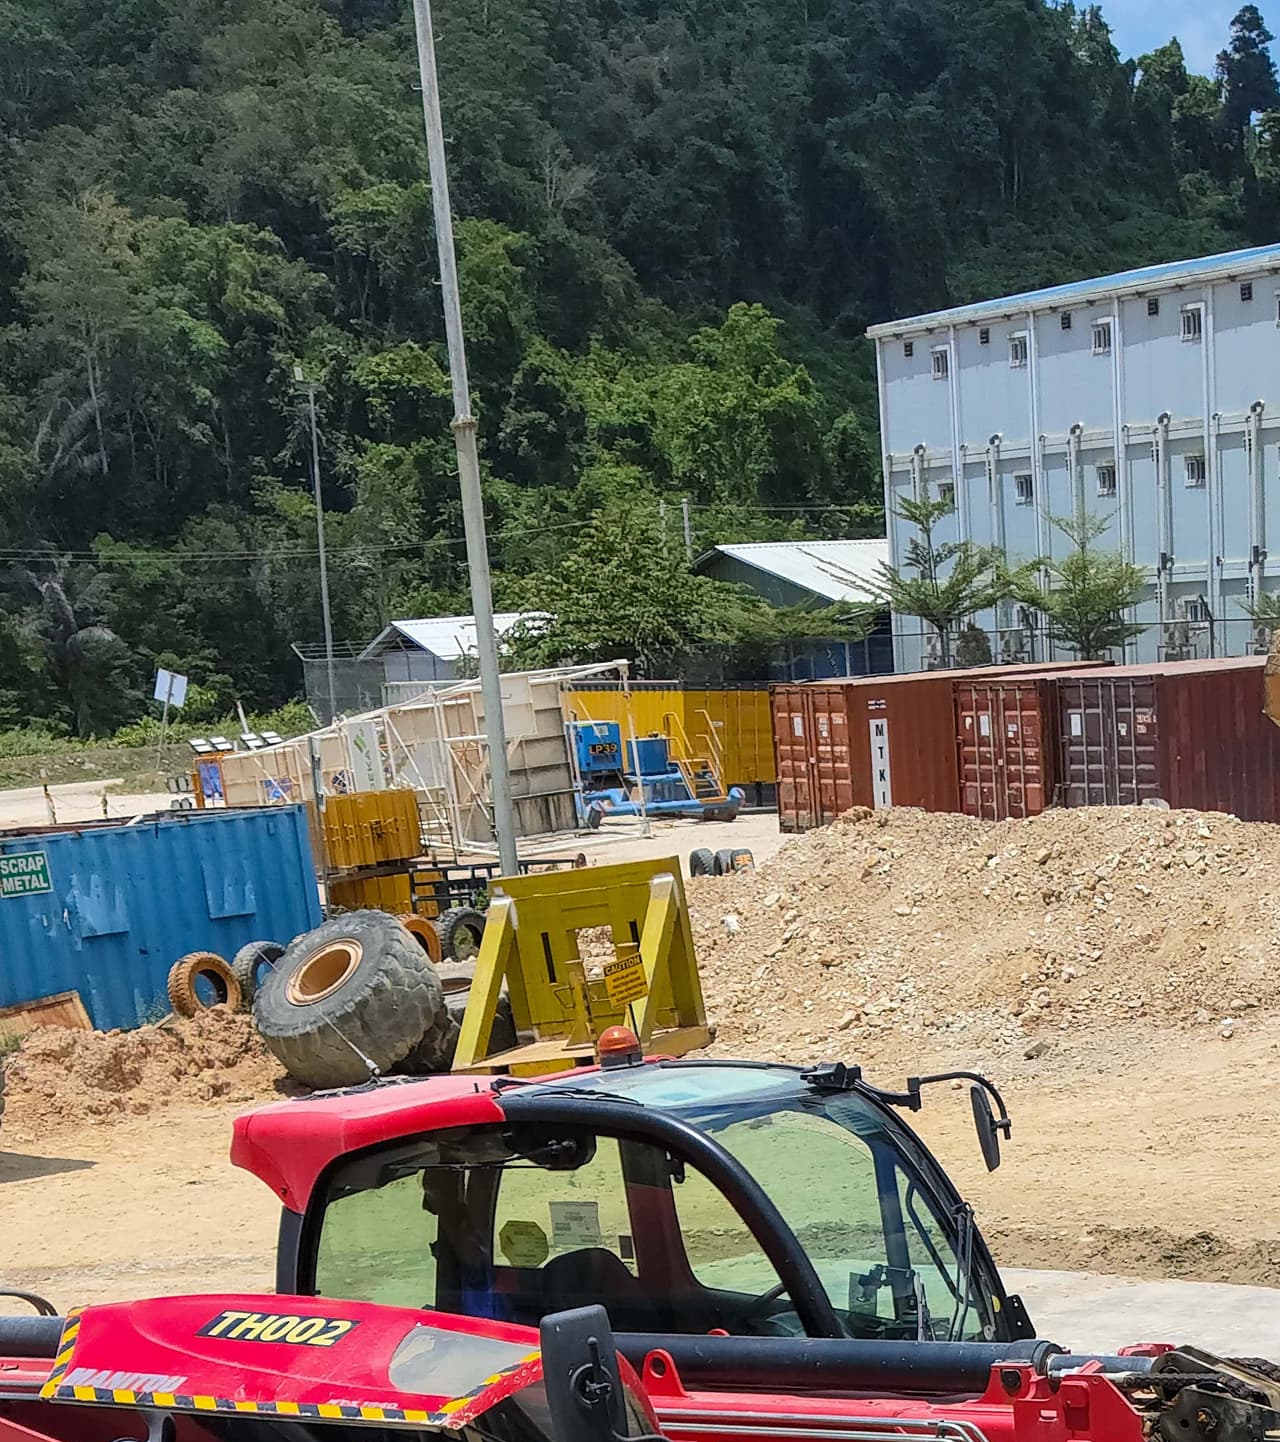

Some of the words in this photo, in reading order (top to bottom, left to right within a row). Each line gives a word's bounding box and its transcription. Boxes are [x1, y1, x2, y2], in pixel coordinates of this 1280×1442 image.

[589, 743, 617, 755] LP39
[0, 856, 44, 874] SCRAP
[2, 873, 48, 892] METAL
[605, 955, 641, 976] CAUTION
[208, 1311, 352, 1346] TH002
[61, 1367, 188, 1393] MANITOU
